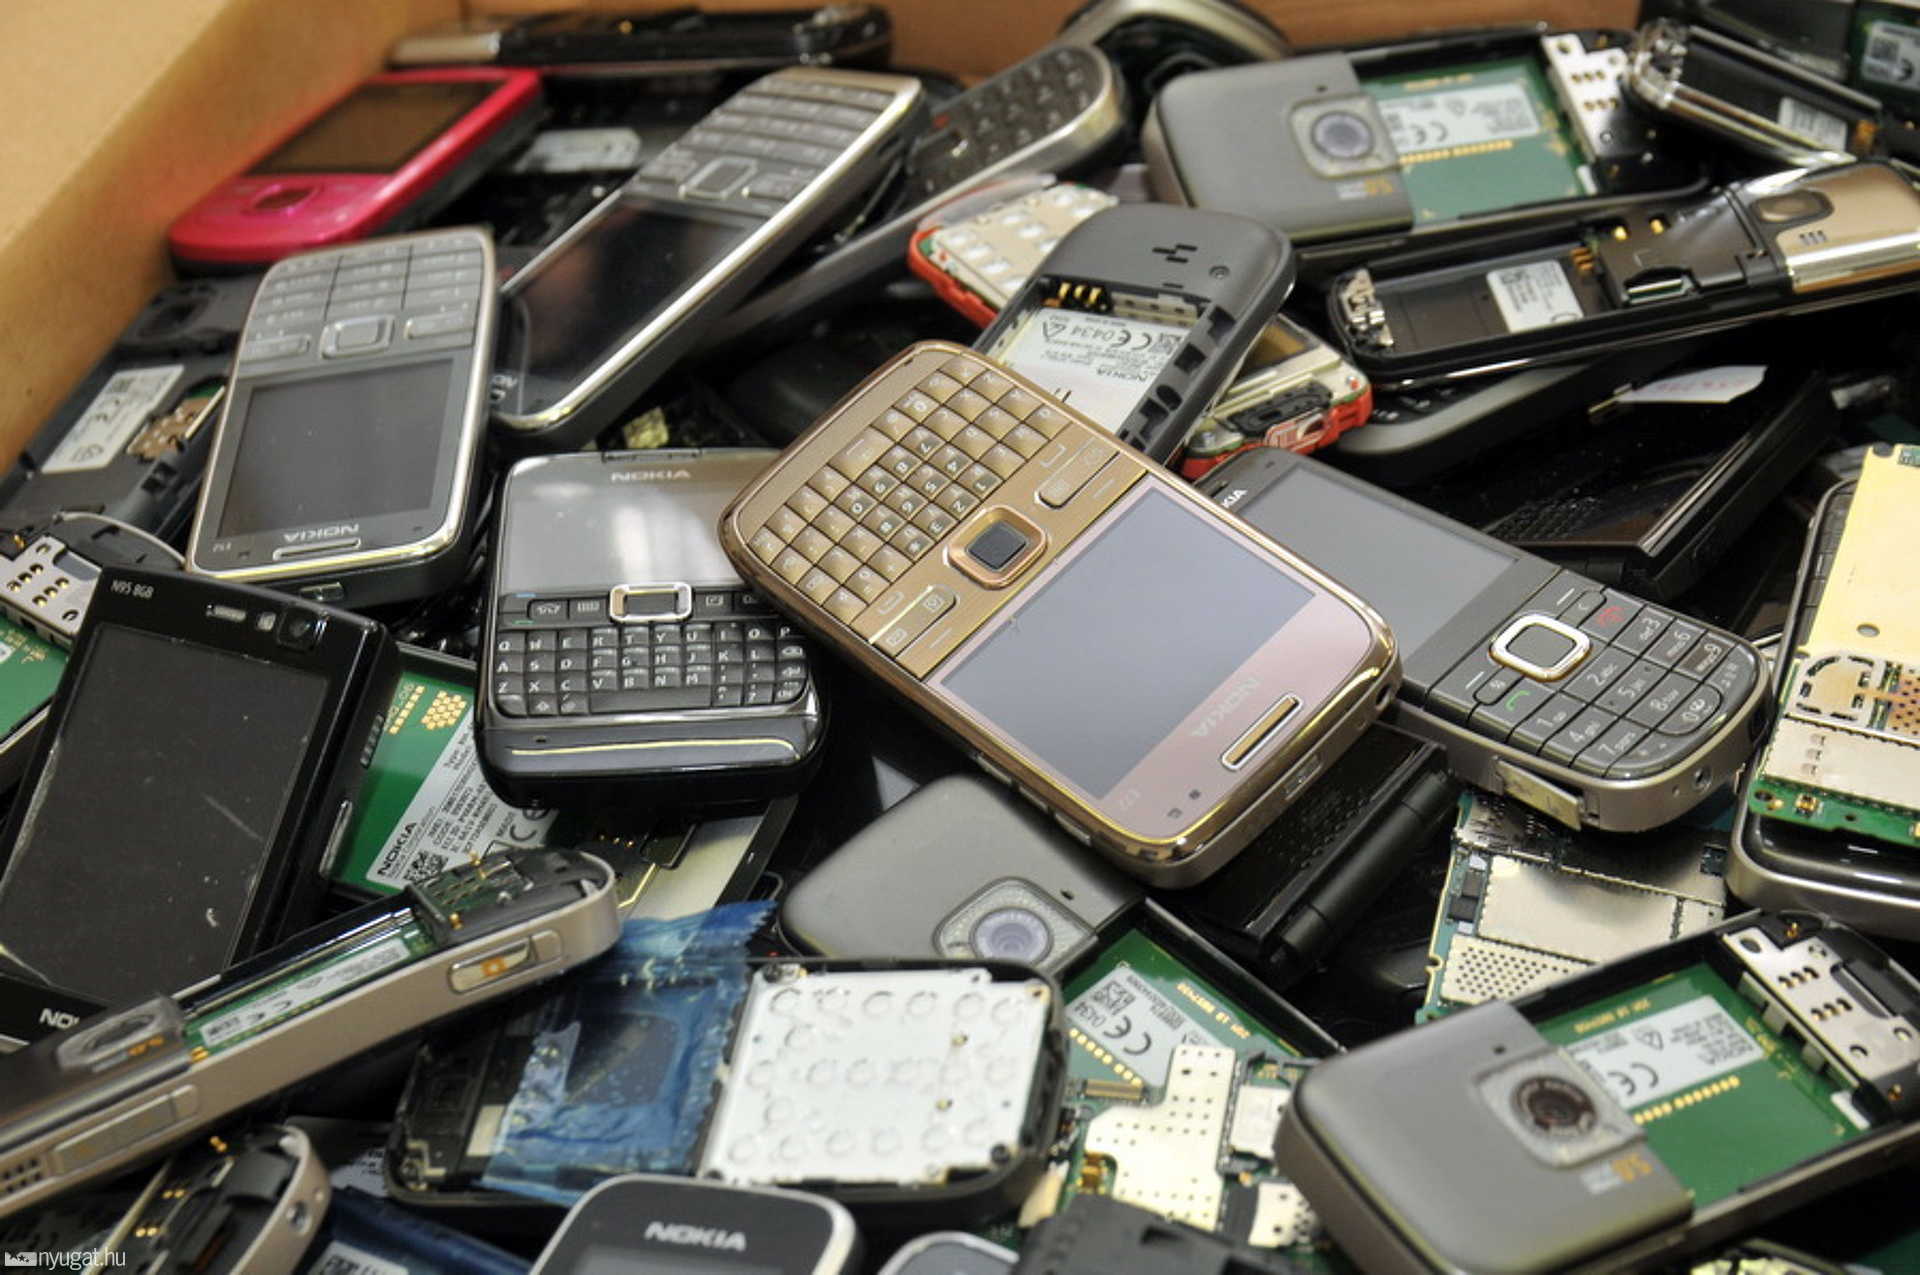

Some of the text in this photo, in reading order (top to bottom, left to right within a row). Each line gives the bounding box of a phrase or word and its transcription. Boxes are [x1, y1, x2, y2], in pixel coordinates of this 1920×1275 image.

[611, 470, 690, 482] NOKIA
[283, 523, 360, 543] NOKIA
[377, 821, 418, 877] NOKIA
[644, 1221, 747, 1251] NOKIA
